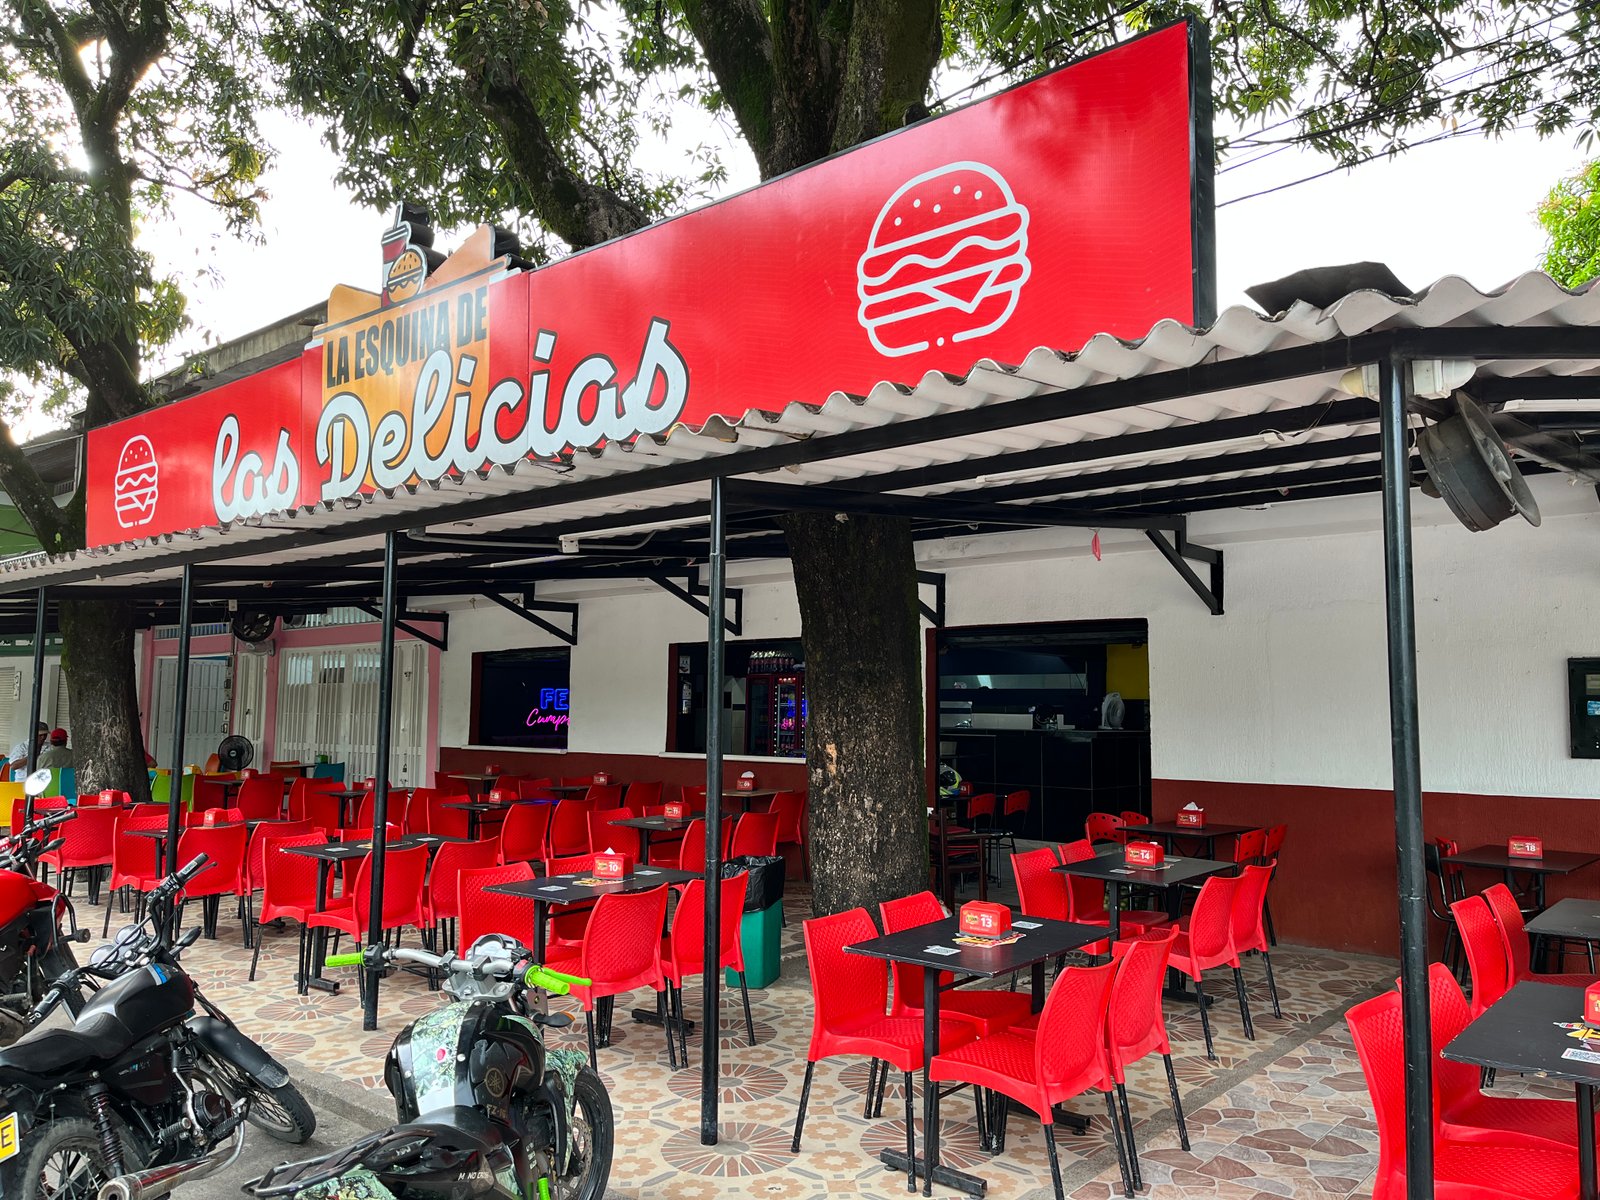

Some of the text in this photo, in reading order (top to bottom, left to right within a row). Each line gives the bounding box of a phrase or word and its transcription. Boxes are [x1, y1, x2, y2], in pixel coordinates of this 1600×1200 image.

[326, 286, 488, 389] LA ESQUINA DE
[212, 316, 690, 524] las Delicias
[540, 688, 569, 710] FE
[1140, 852, 1150, 860] 14
[609, 863, 618, 872] 10
[980, 917, 993, 928] 13
